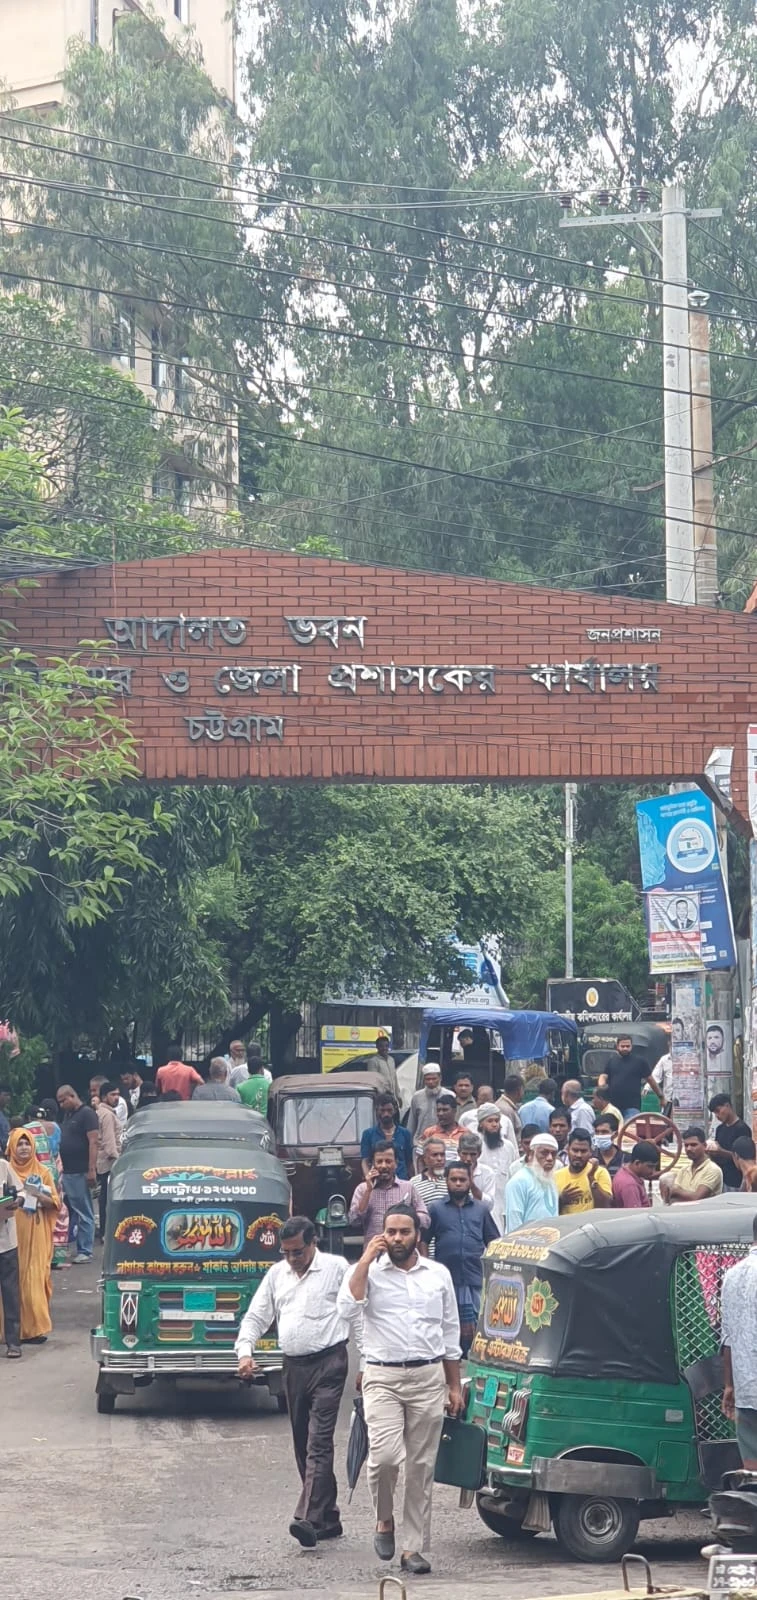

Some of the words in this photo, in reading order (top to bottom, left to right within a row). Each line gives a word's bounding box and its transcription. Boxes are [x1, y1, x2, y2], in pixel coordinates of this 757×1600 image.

[104, 612, 250, 650] আদালত
[284, 616, 368, 649] ভবন
[585, 625, 662, 643] জনপ্রশাসন
[161, 669, 190, 694] ও
[213, 664, 303, 694] জেলা
[328, 661, 497, 695] প্রশাসকের
[527, 656, 661, 693] কার্যালয়
[184, 710, 285, 743] চট্টগ্রাম
